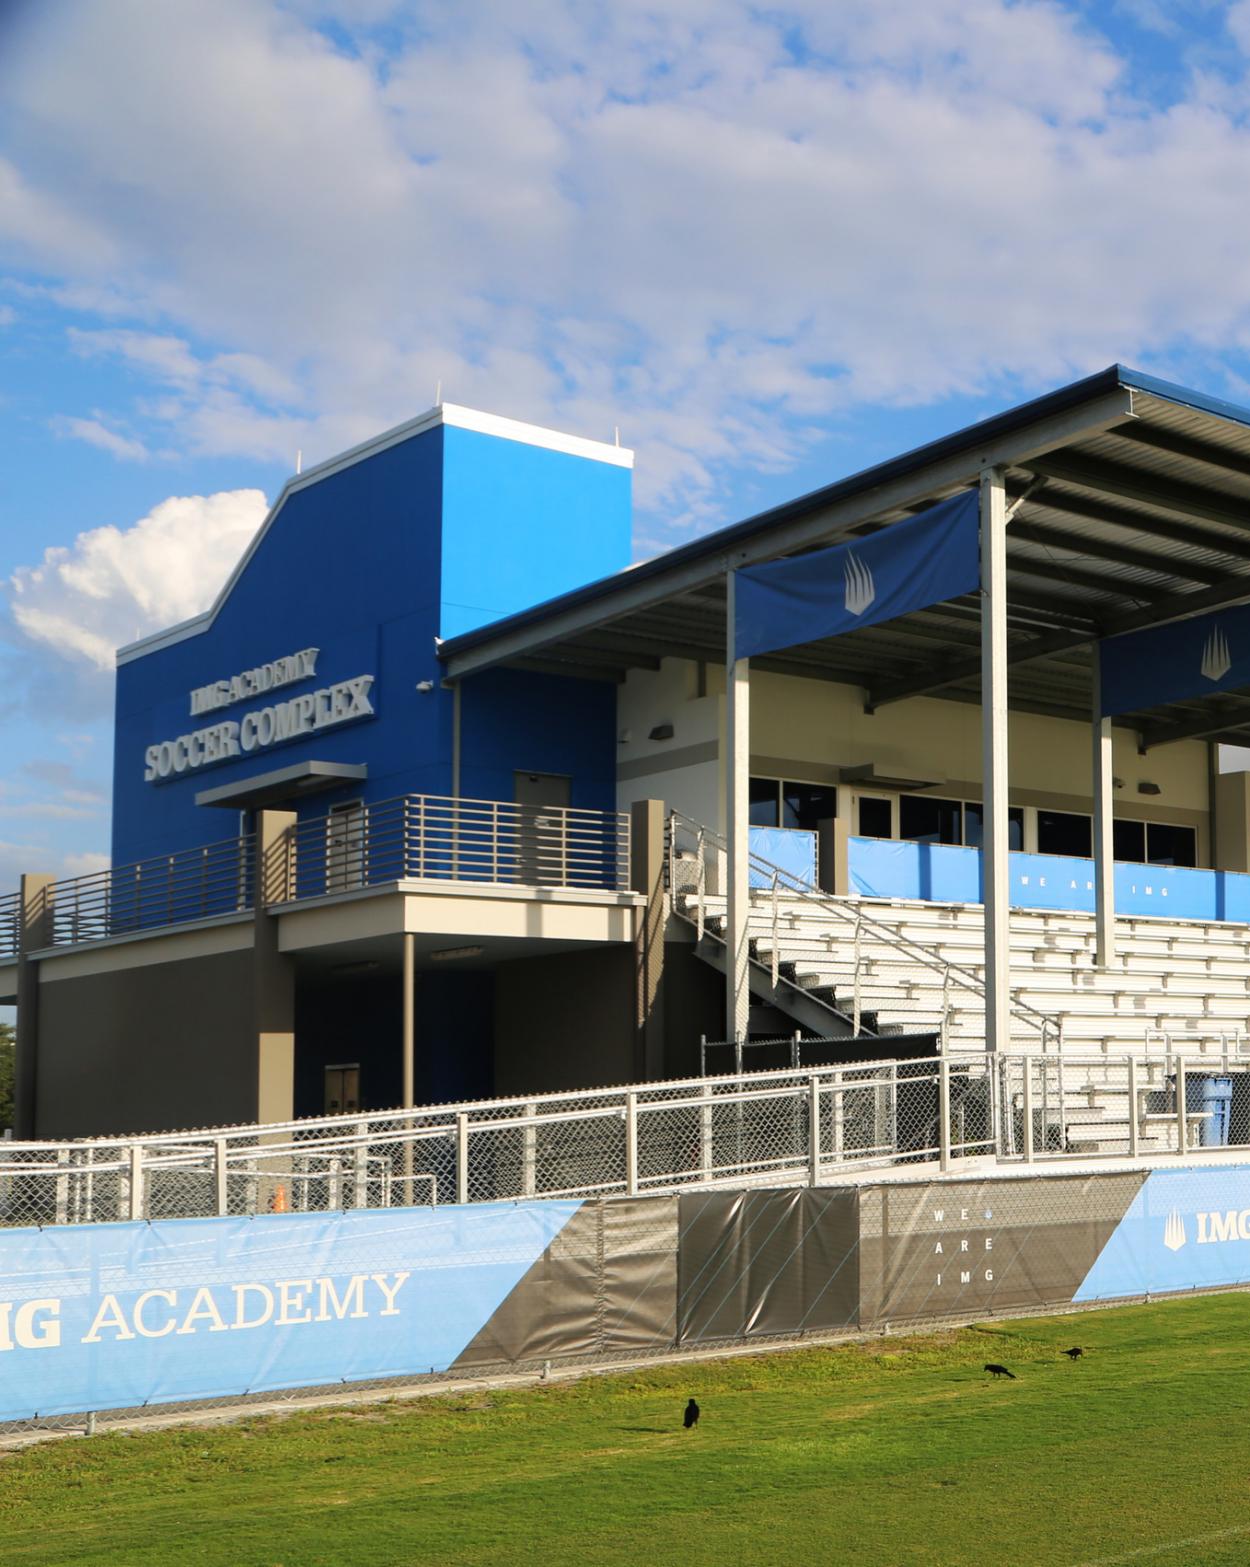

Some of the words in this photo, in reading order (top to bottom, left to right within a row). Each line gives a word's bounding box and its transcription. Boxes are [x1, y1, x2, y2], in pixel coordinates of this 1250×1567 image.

[190, 680, 230, 716] IMG
[229, 648, 320, 703] ACADEMY
[144, 721, 241, 782] SOCCER
[241, 675, 374, 751] COMPLEX
[1021, 876, 1046, 887] WE
[1131, 885, 1168, 897] IMG
[934, 1208, 968, 1221] WE
[935, 1238, 992, 1253] ARE
[937, 1269, 993, 1285] IMG
[81, 1272, 410, 1343] ACADEMY
